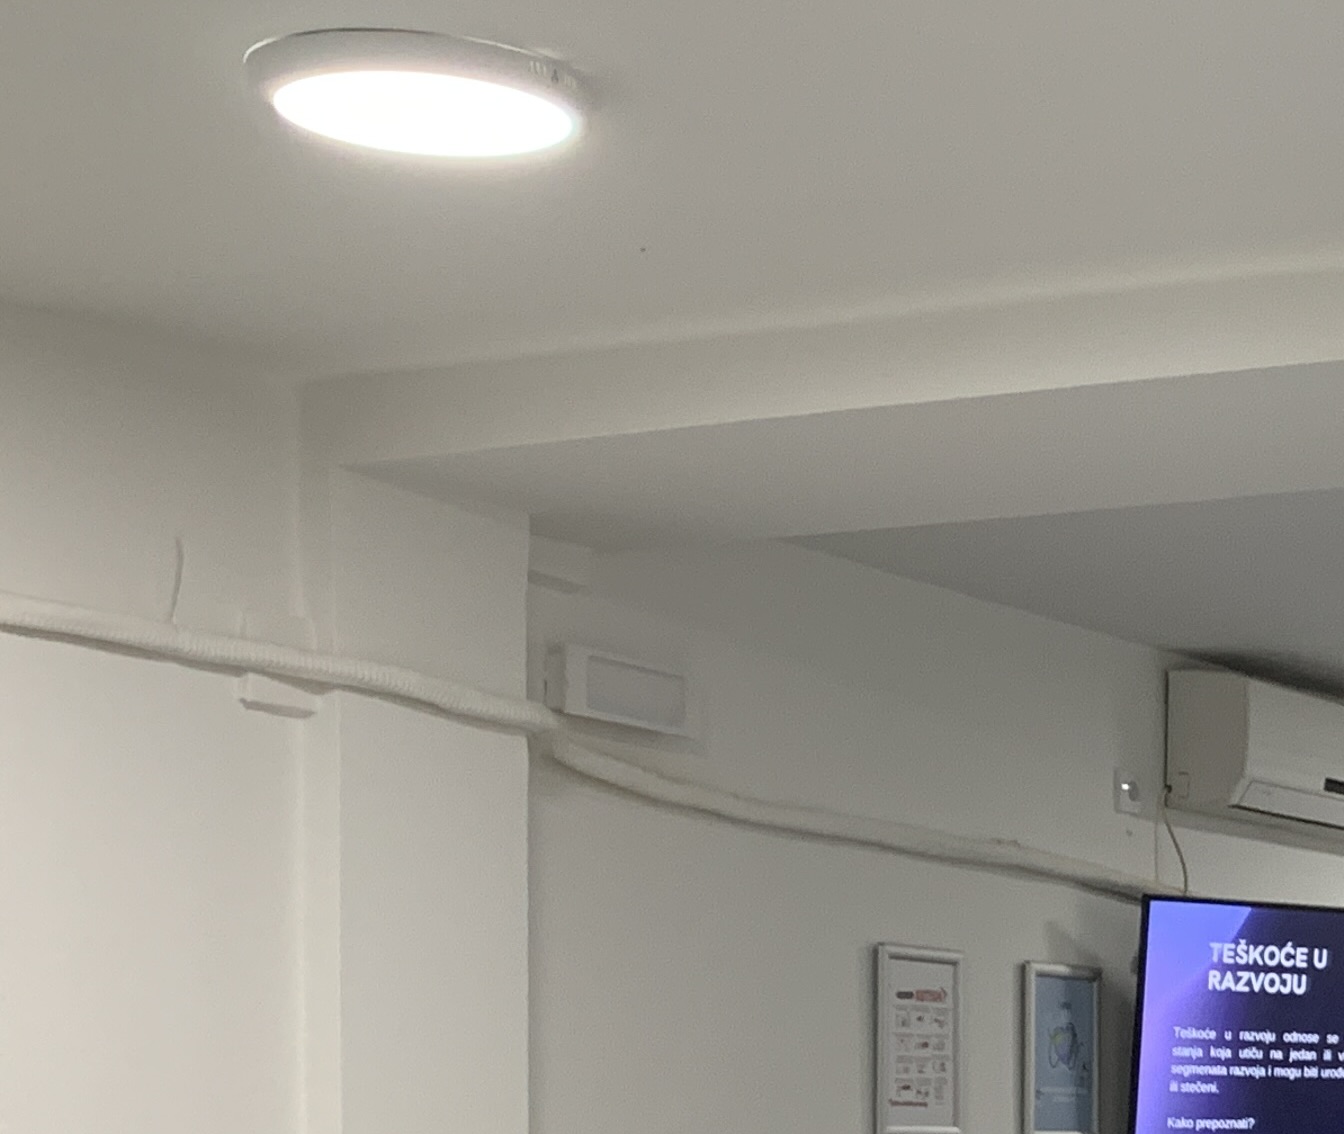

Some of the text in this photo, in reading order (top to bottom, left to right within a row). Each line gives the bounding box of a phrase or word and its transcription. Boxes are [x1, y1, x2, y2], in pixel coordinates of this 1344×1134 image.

[1209, 939, 1328, 970] TEŠKOĆE U
[1207, 969, 1307, 995] RAZVOJU
[1173, 1026, 1216, 1040] Teškoće
[1224, 1030, 1232, 1041] u
[1239, 1029, 1276, 1044] razvoju
[1283, 1031, 1320, 1043] odnose
[1326, 1033, 1339, 1044] se
[1172, 1045, 1203, 1060] stanja
[1210, 1046, 1232, 1060] koja
[1270, 1049, 1283, 1060] na
[1289, 1048, 1317, 1063] jedan
[1170, 1064, 1227, 1077] segmenata
[1229, 1065, 1266, 1080] razvoja
[1273, 1067, 1301, 1080] mogu
[1167, 1117, 1255, 1132] Kako prepoznati?
